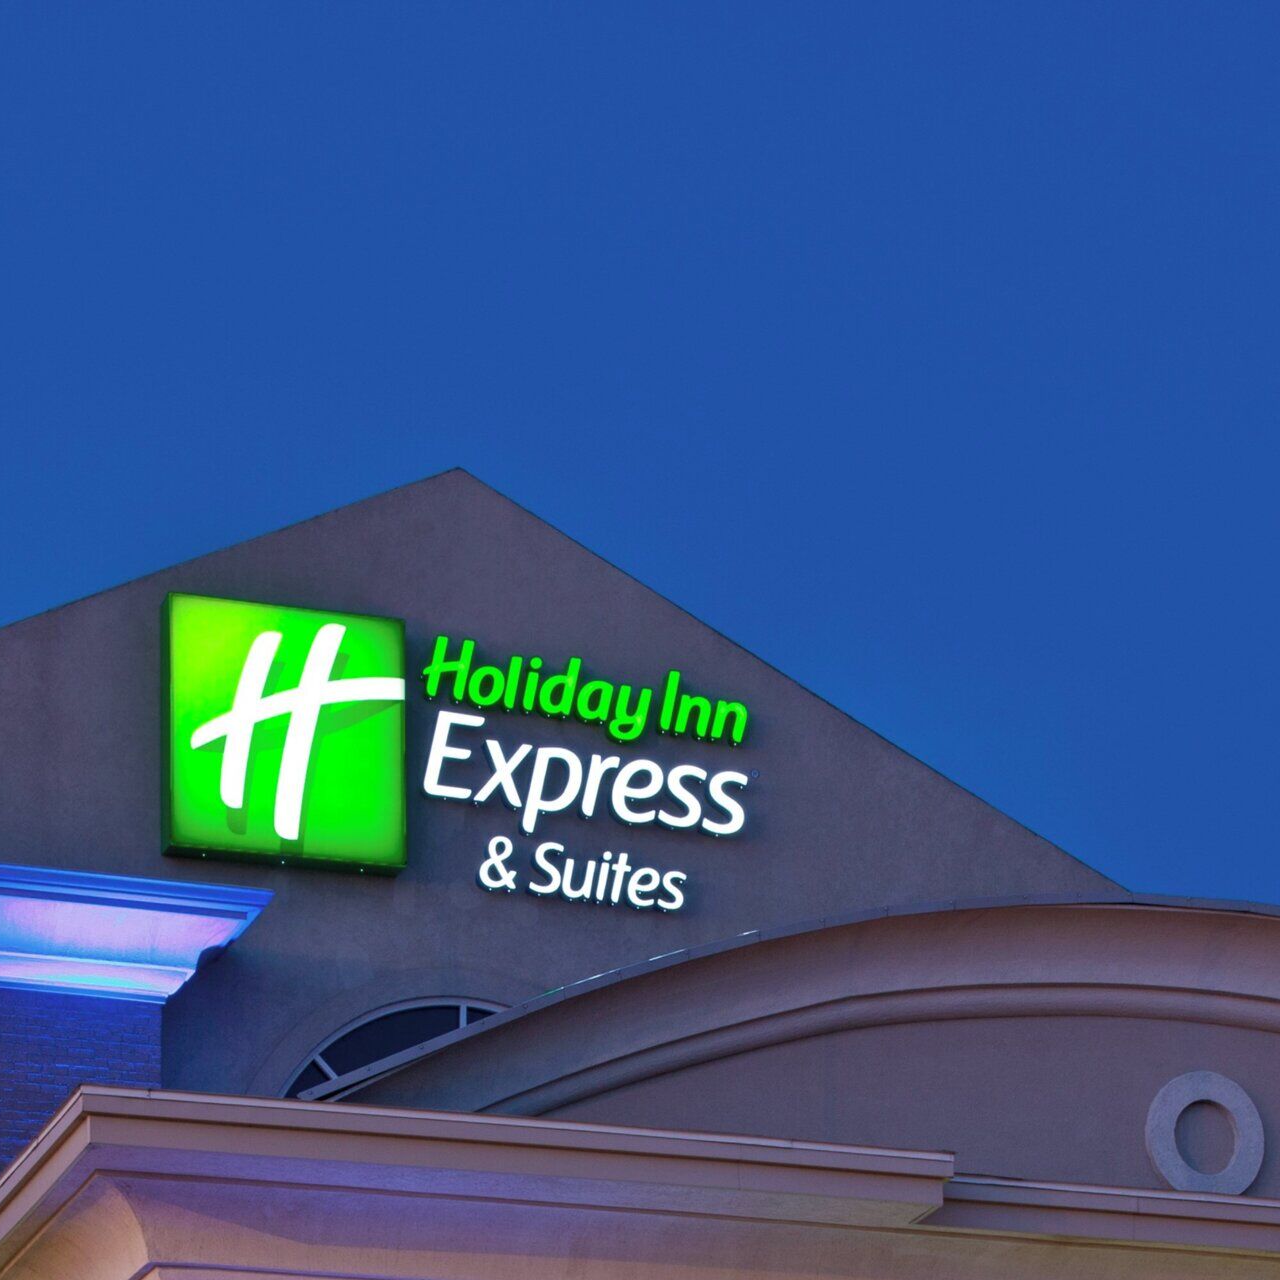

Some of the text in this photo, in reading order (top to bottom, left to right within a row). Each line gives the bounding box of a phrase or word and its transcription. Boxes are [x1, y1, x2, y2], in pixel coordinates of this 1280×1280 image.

[422, 635, 749, 744] Holiday Inn
[423, 710, 750, 835] Express
[479, 835, 688, 911] & Suites
